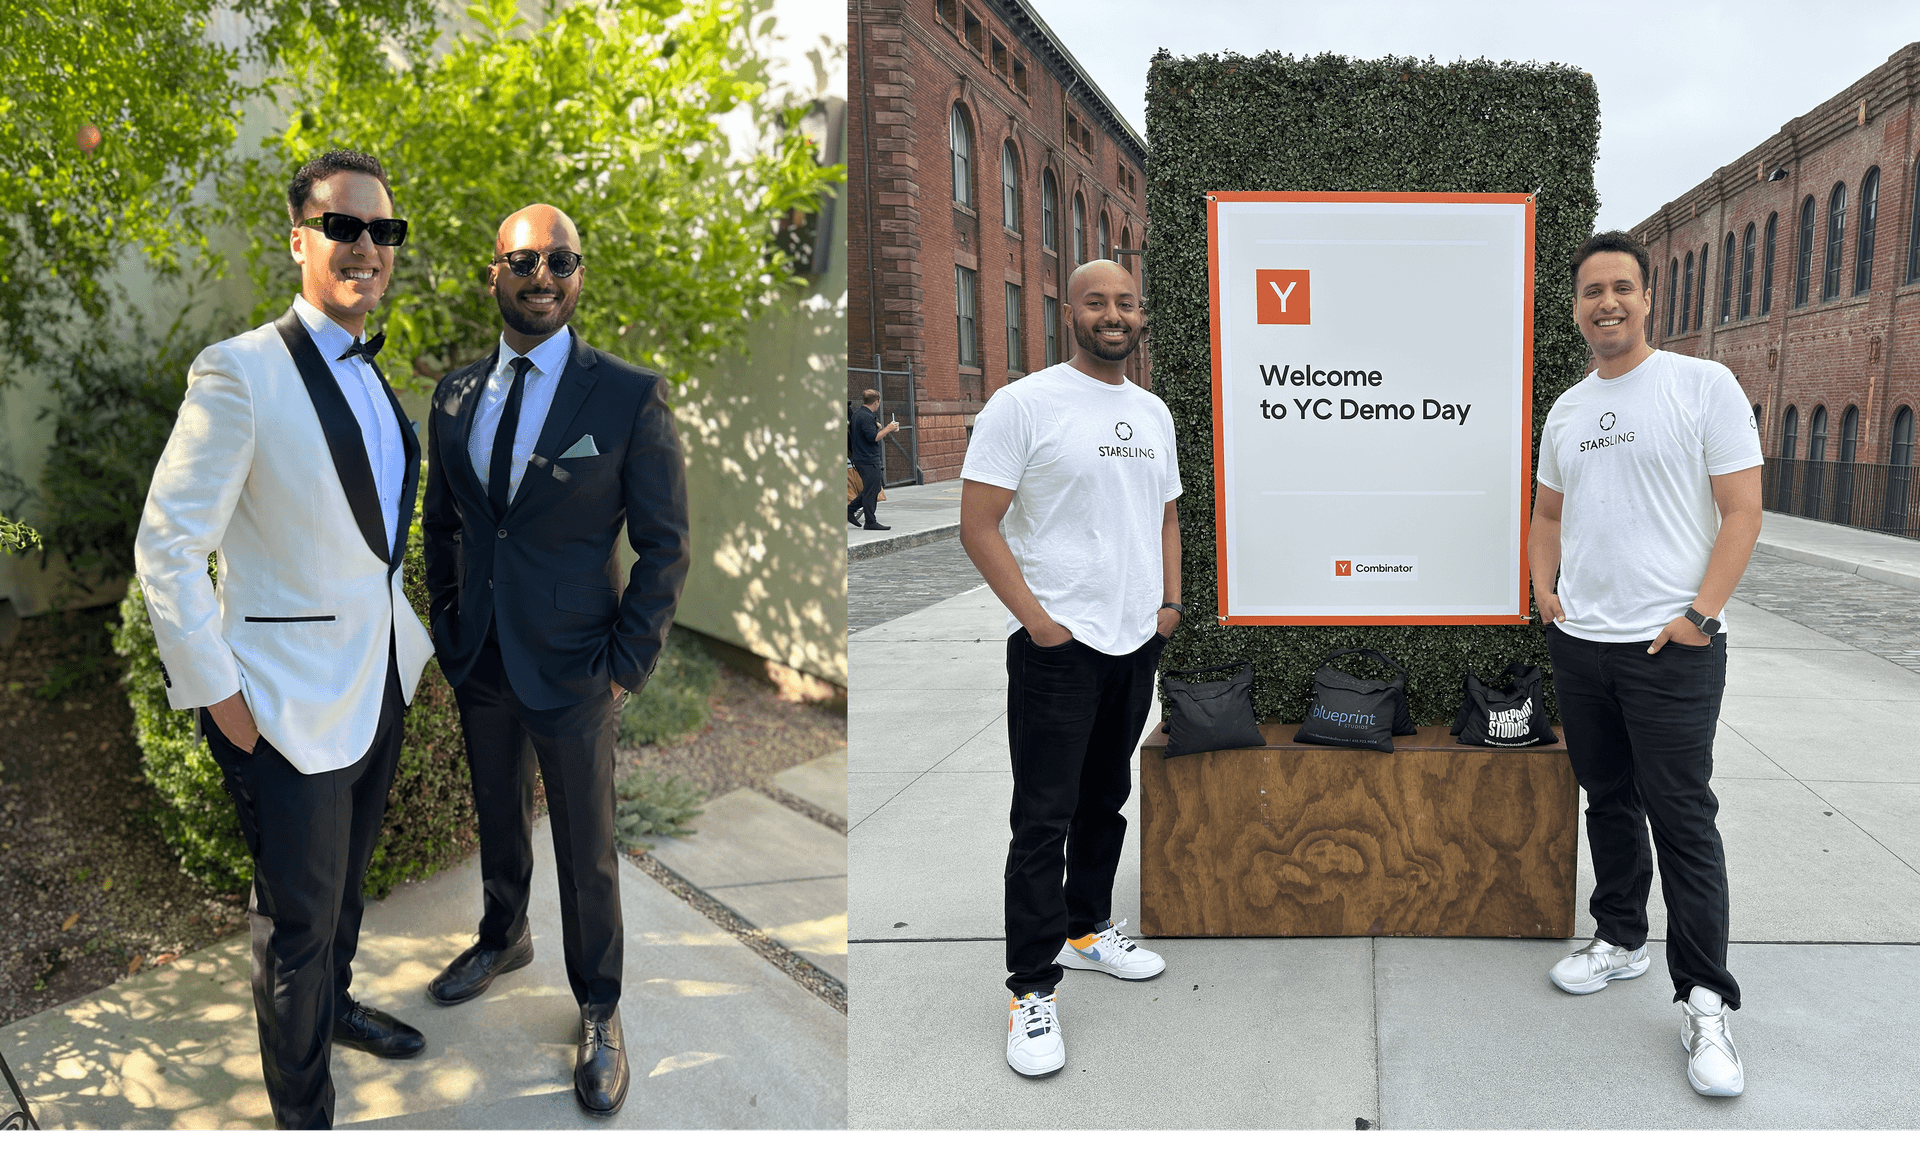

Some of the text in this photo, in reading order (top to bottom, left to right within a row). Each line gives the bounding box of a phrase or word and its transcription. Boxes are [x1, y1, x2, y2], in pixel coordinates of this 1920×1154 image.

[1269, 281, 1298, 313] Y
[1259, 364, 1383, 387] Welcome
[1260, 398, 1472, 426] to YC Demo Day
[1098, 446, 1155, 459] STARSLING
[1579, 431, 1636, 453] STARSLING
[1339, 563, 1414, 574] Y Combinator
[1313, 703, 1376, 726] blueprint
[1488, 718, 1530, 739] STUDIOS
